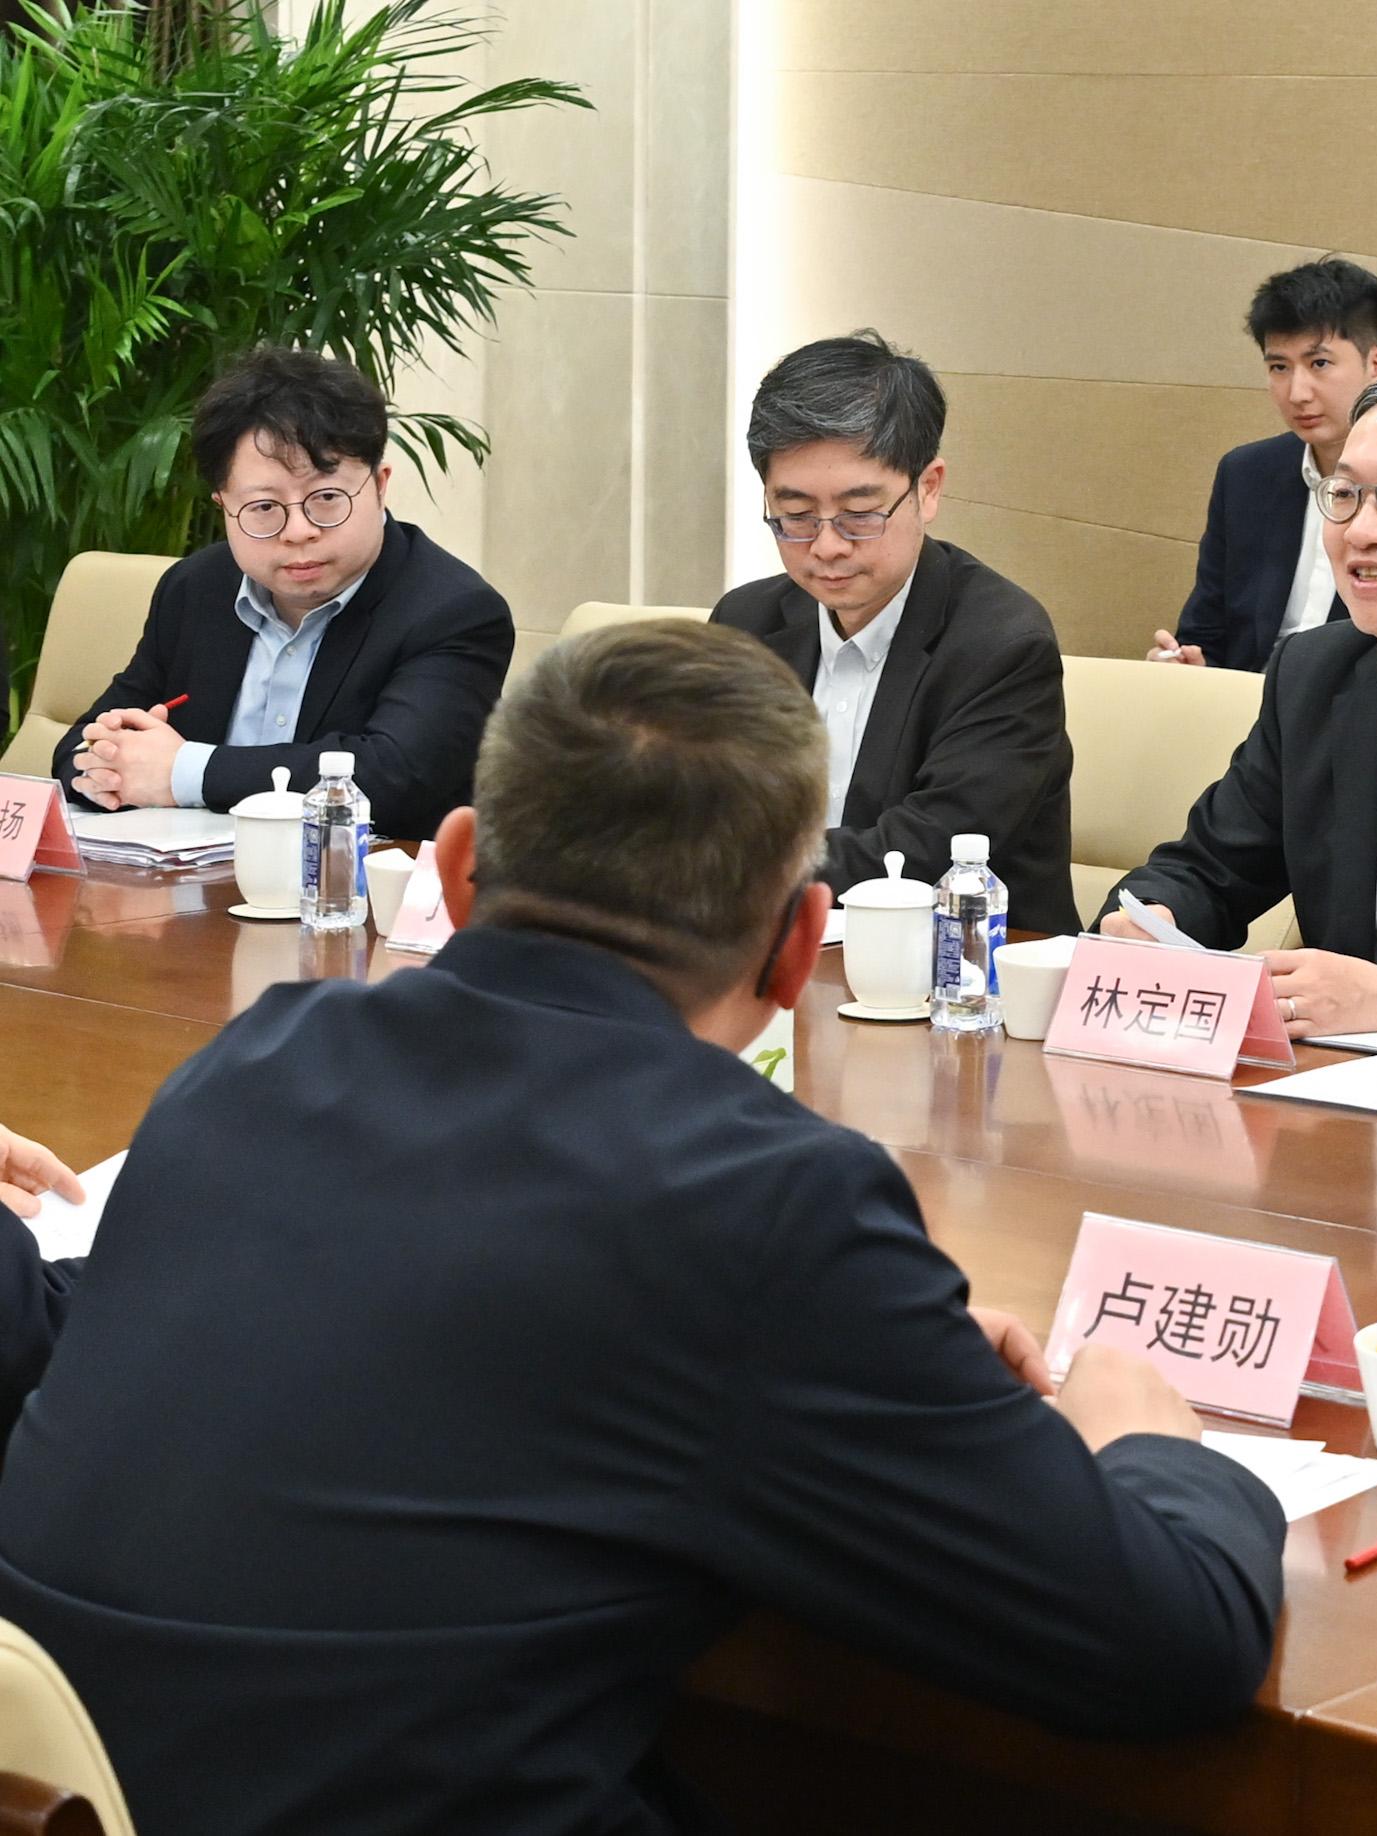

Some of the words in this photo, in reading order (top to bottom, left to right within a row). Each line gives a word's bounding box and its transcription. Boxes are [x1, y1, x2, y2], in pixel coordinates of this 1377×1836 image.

[1080, 974, 1227, 1045] 林定国
[1083, 1271, 1281, 1370] 卢建勋
